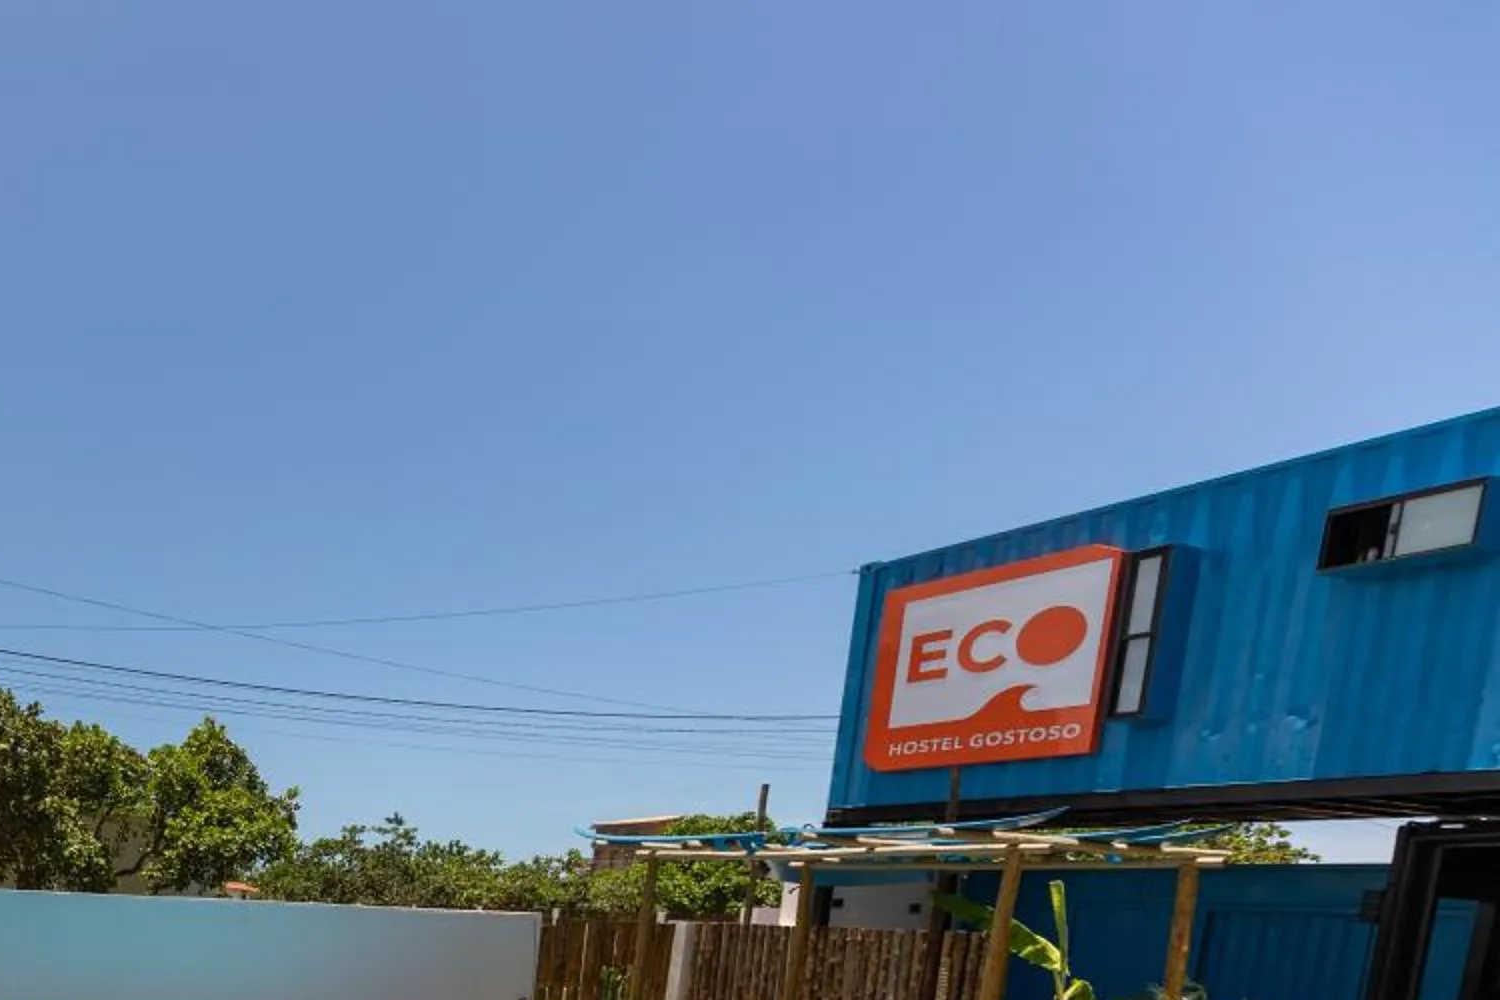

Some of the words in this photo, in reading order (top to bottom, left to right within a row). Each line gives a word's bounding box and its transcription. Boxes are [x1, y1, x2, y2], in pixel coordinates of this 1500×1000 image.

[906, 605, 1088, 684] ECO
[888, 735, 963, 757] HOSTEL
[969, 723, 1082, 748] GOSTOSO
